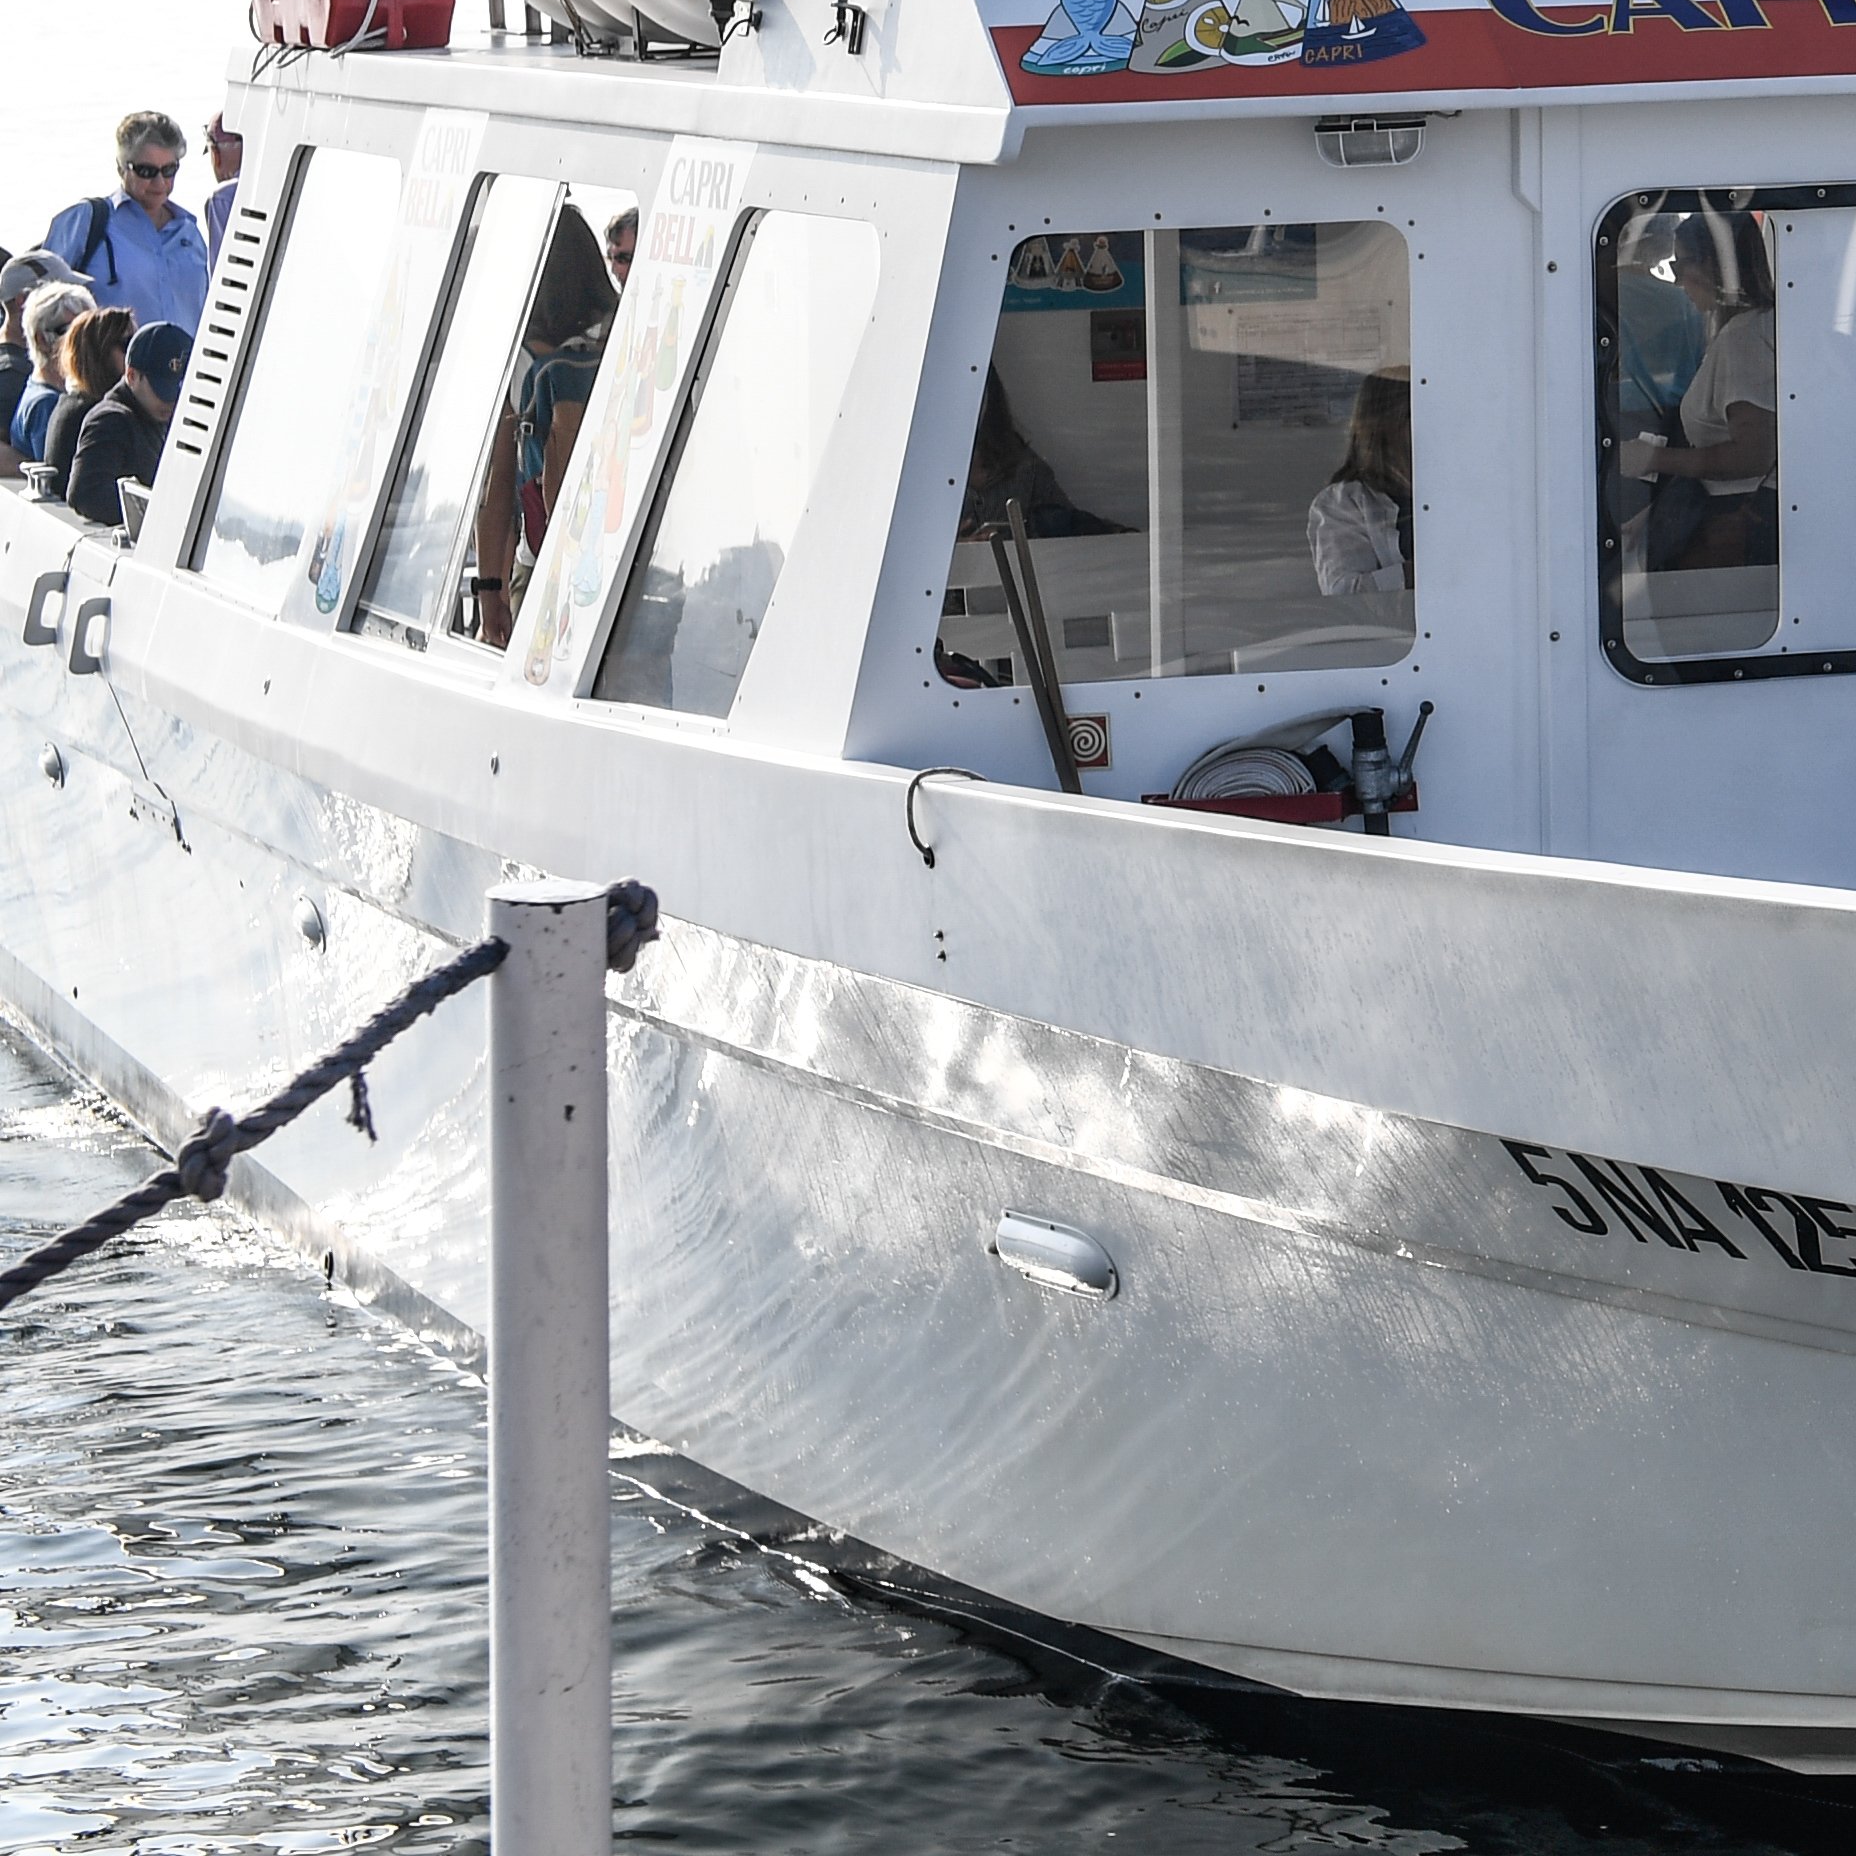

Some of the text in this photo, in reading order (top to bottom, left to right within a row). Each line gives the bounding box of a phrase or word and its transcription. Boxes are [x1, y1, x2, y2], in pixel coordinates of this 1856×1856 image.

[1304, 43, 1363, 65] CAPRI
[421, 125, 472, 176] CAPRI
[670, 156, 736, 211] CAPRI
[1499, 1138, 1749, 1261] 5NA
